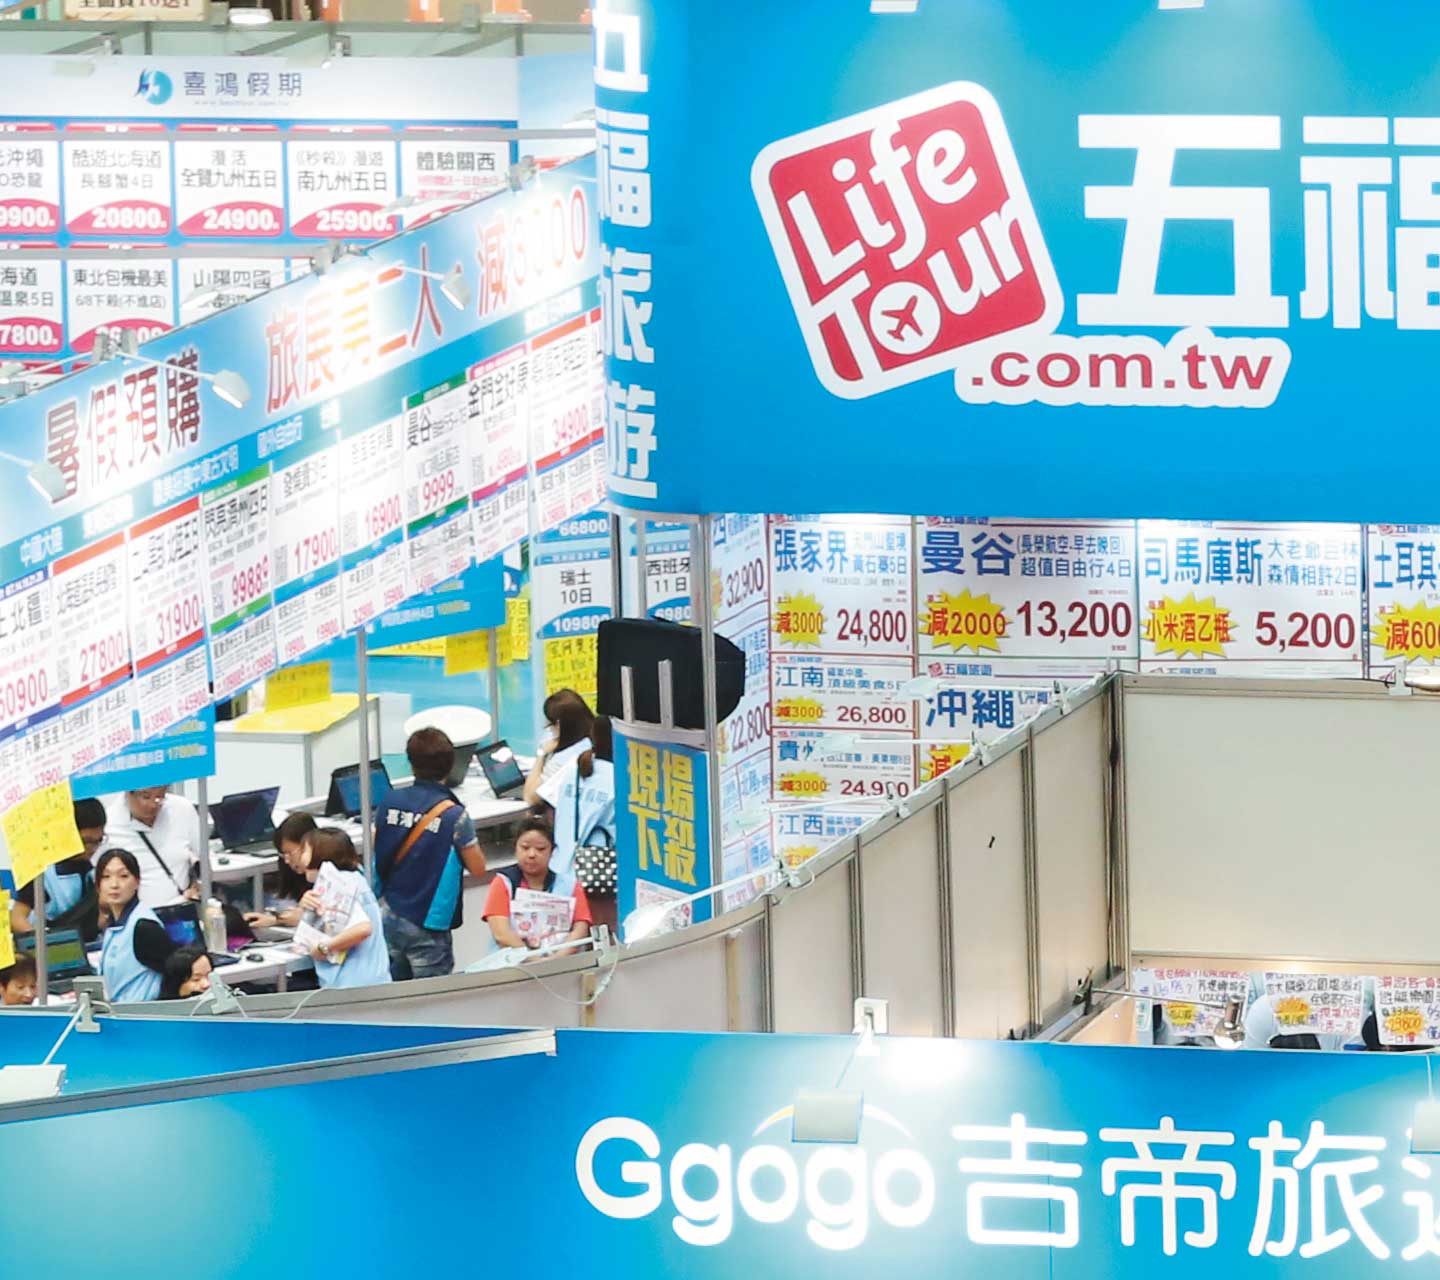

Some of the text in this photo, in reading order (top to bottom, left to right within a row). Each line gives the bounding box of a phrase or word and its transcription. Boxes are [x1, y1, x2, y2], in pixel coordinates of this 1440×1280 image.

[183, 70, 304, 98] 喜鴻假期
[91, 208, 161, 228] 20800
[203, 209, 274, 229] 24900
[970, 344, 1273, 391] .com.tw
[773, 528, 854, 574] 張家界
[920, 529, 1017, 578] 曼谷
[1020, 558, 1132, 580] 超值自由行4日
[836, 607, 907, 645] 24,800
[925, 605, 1007, 638] 減2000
[1015, 600, 1133, 640] 13,200
[1254, 610, 1356, 649] 5,200
[775, 665, 825, 689] 江南
[836, 705, 907, 725] 26,800
[925, 687, 1015, 730] 沖繩
[574, 1115, 937, 1253] Ggogo
